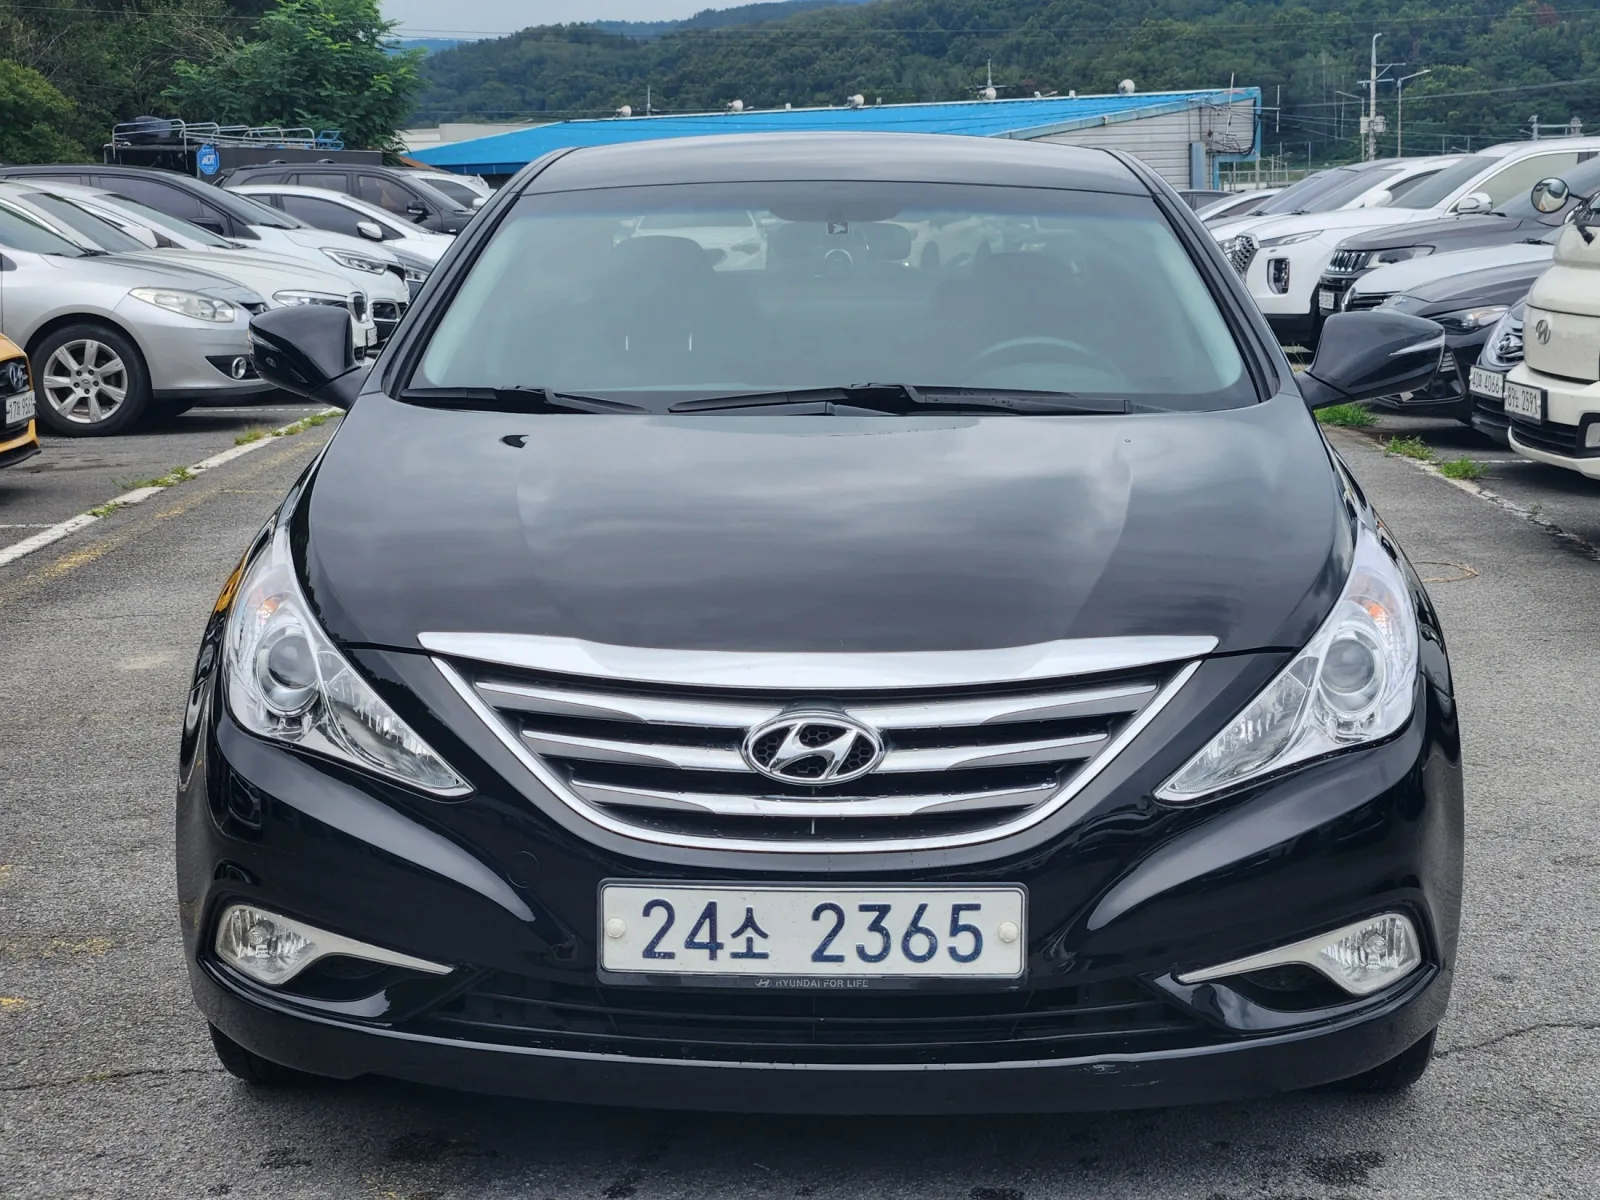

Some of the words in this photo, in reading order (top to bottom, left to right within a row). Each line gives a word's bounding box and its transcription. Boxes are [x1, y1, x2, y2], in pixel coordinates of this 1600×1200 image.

[1484, 374, 1500, 394] 4066
[1522, 390, 1538, 414] 2591
[642, 898, 770, 961] 24소
[811, 902, 984, 963] 2365
[775, 979, 820, 988] HYUNDAI
[823, 979, 844, 988] FOR
[847, 979, 869, 988] LIFE
